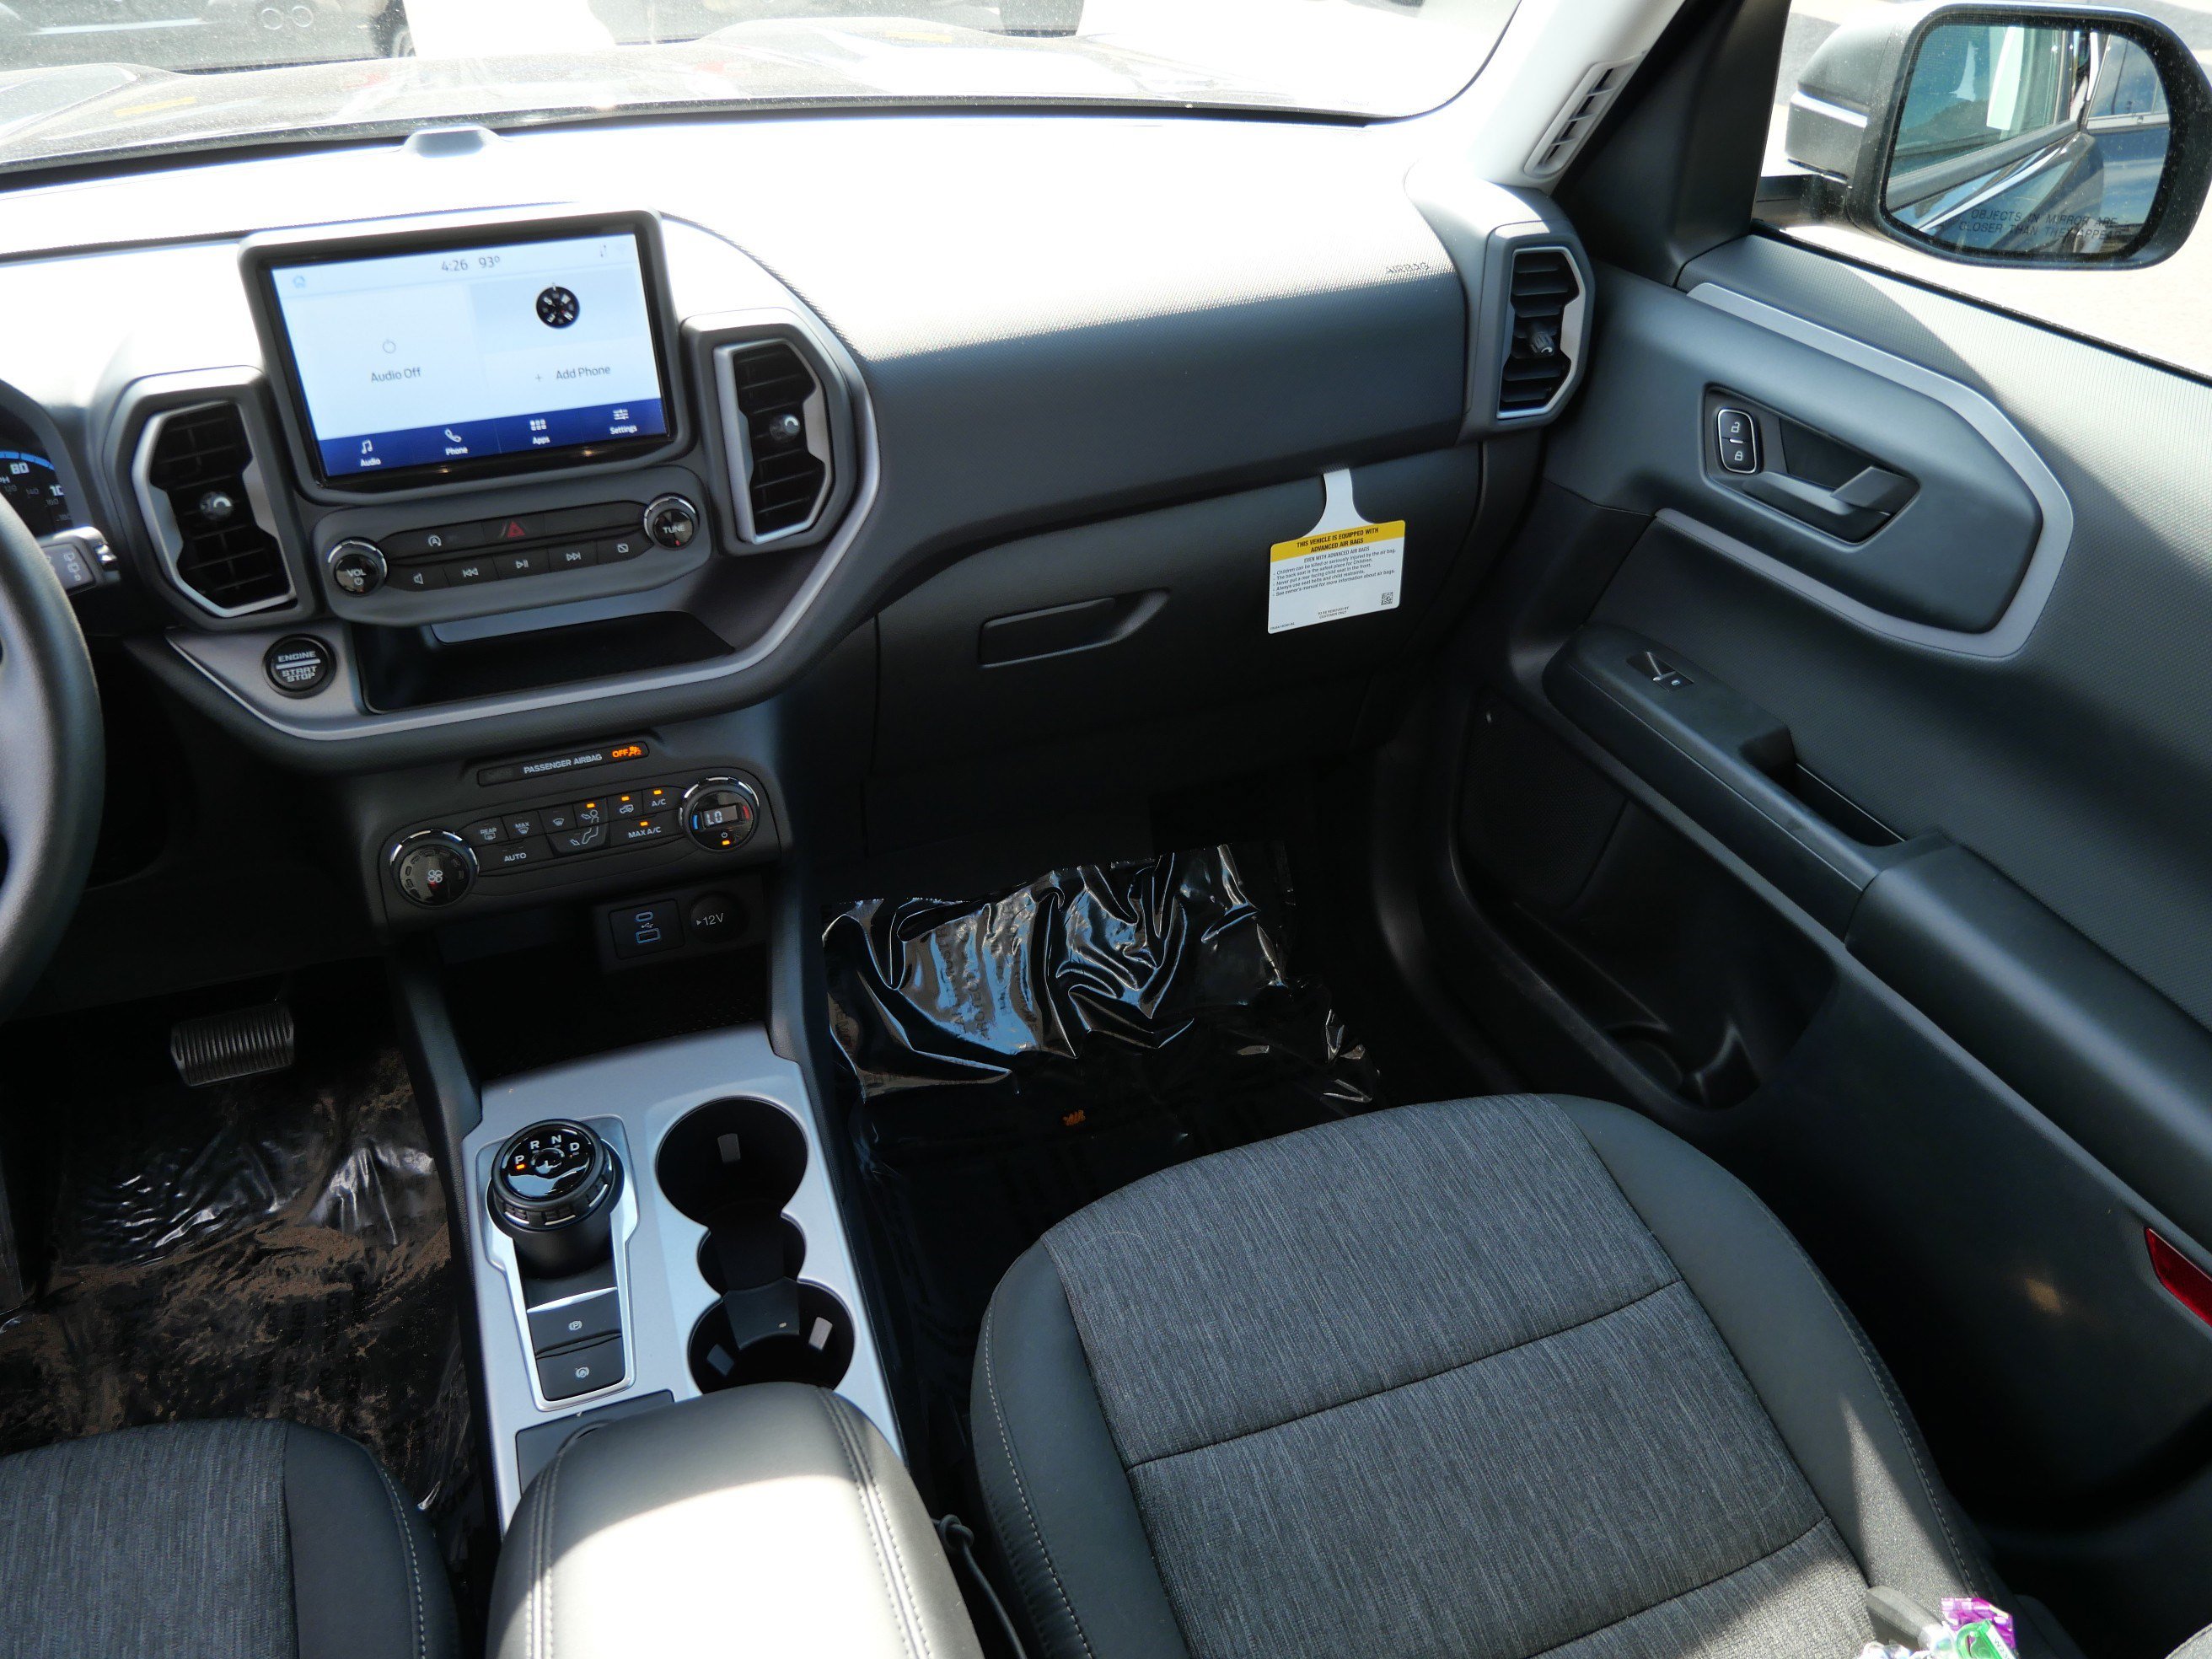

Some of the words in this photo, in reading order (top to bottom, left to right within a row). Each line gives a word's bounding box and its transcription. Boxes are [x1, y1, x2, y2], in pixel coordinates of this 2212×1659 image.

[1971, 209, 2022, 222] OBJECTS
[2027, 212, 2039, 223] IN
[2047, 214, 2091, 225] MIRROR
[1958, 221, 2003, 233] CLOSER
[2011, 225, 2038, 235] THAN
[441, 259, 469, 272] 4:26
[371, 369, 402, 384] Audio
[403, 367, 421, 379] Off
[556, 368, 577, 380] Add
[577, 364, 611, 379] Phone
[609, 424, 637, 436] Settings
[532, 436, 550, 445] Apps
[445, 445, 468, 455] Phone
[360, 457, 381, 467] Audio
[10, 462, 30, 475] 80
[663, 523, 685, 534] TUNE
[1310, 536, 1330, 545] VEHICLE
[1339, 529, 1364, 540] EQUIPPED
[1310, 542, 1339, 553] ADVANCED
[1350, 537, 1364, 545] BAGS
[1328, 550, 1350, 559] ADVANCED
[346, 567, 367, 577] VOL
[1339, 574, 1363, 583] information
[277, 650, 316, 663] ENGINE
[282, 666, 317, 678] START
[286, 672, 315, 683] STOP
[523, 760, 572, 774] PASSENGER
[573, 753, 603, 765] AIRBAG
[612, 749, 629, 758] OFF
[651, 798, 667, 808] A/C
[515, 820, 530, 830] MAX
[480, 827, 497, 835] REAR
[628, 830, 646, 839] MAX
[646, 826, 662, 835] A/C
[504, 852, 527, 862] AUTO
[702, 912, 724, 926] 12V
[530, 1140, 540, 1150] R
[551, 1135, 562, 1145] N
[570, 1142, 580, 1152] D
[515, 1155, 525, 1165] P
